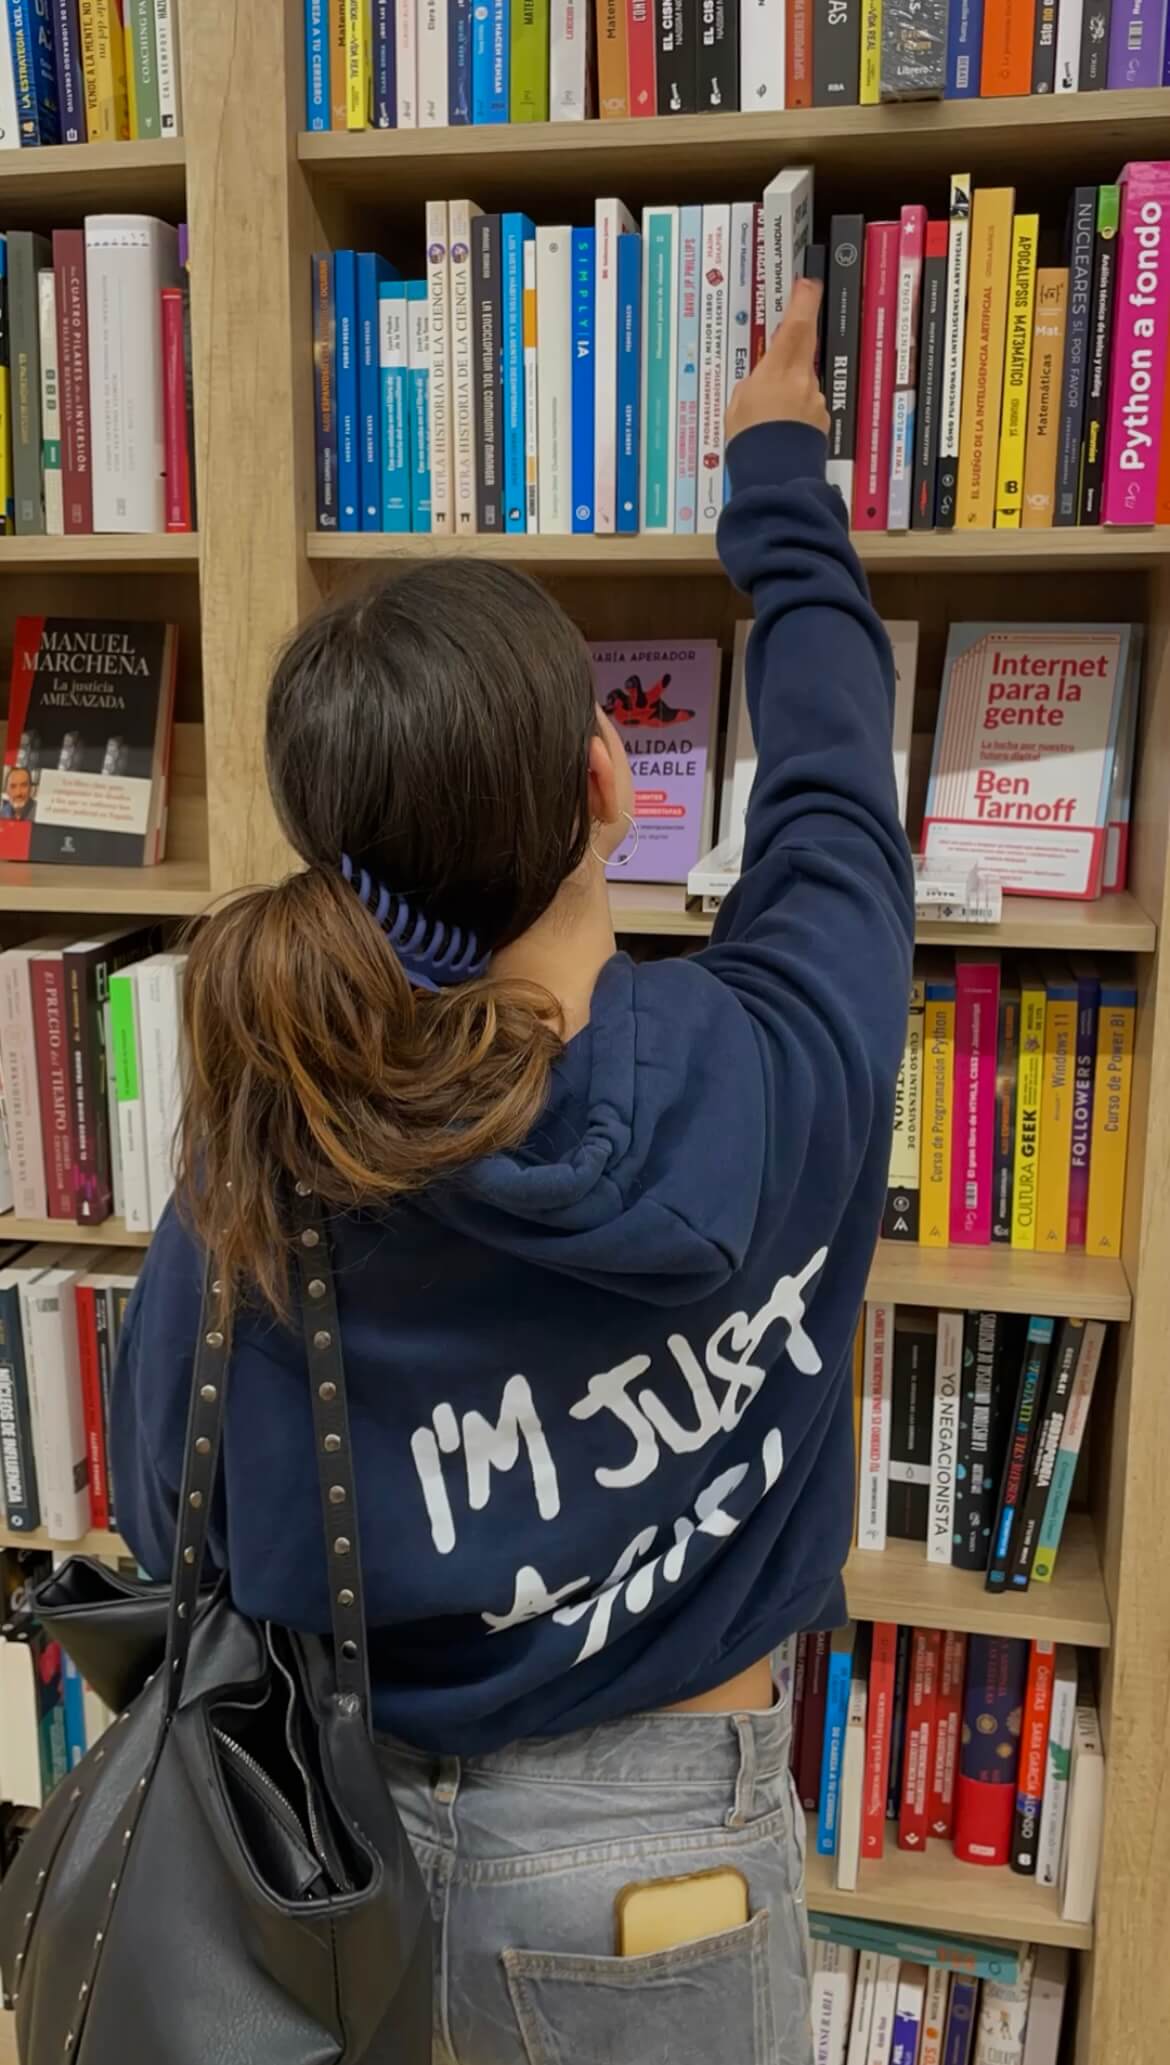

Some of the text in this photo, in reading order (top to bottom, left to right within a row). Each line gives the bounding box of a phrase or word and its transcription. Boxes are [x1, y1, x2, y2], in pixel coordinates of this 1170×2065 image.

[137, 17, 151, 84] COACHING
[663, 34, 675, 51] EL
[703, 27, 715, 45] EL
[1040, 23, 1053, 46] Esto
[87, 77, 98, 110] VENDE
[773, 214, 784, 259] JANDIAL
[774, 260, 784, 294] RAHUL
[1014, 235, 1034, 308] APOCALIPSIS
[1072, 202, 1094, 317] NUCLEARES
[1099, 253, 1112, 288] Análisis
[430, 270, 444, 328] CIENCIA
[453, 270, 468, 328] CIENCIA
[73, 331, 84, 383] PILARES
[430, 333, 443, 352] LA
[453, 333, 467, 352] LA
[577, 339, 590, 359] IA
[704, 322, 714, 352] MEJOR
[945, 231, 965, 449] CÓMO FUNCIONA LA INTELIGENCIA ARTIFICIAL
[1119, 201, 1164, 473] Python a fondo
[431, 359, 444, 378] DE
[454, 359, 467, 378] DE
[483, 372, 496, 387] DEL
[735, 346, 748, 380] Esta
[832, 354, 849, 412] RUBIK
[970, 286, 994, 500] EL SUEÑO DE LA INTELIGENCIA ARTIFICIAL
[1036, 353, 1054, 437] Matemáticas
[1066, 367, 1082, 410] FAVOR
[432, 385, 446, 454] HISTORIA
[454, 385, 470, 454] HISTORIA
[21, 652, 151, 677] MARCHENA
[39, 631, 137, 656] MANUEL
[629, 650, 697, 663] APERADOR
[53, 677, 115, 698] La justicia
[991, 653, 1109, 679] Internet
[39, 693, 126, 710] AMENAZADA
[987, 679, 1082, 706] para la
[983, 704, 1066, 731] gente
[975, 768, 1031, 797] Ben
[974, 795, 1079, 824] Tarnoff
[45, 988, 64, 1050] PRECIO
[933, 1010, 951, 1058] Python
[1051, 1012, 1071, 1089] Windows 11
[907, 1030, 921, 1150] CURSO INTENSIVO DE
[1102, 1012, 1124, 1134] Curso de Power BI
[52, 1068, 68, 1133] TIEMPO
[1071, 1055, 1091, 1168] FOLLOWERS
[933, 1132, 943, 1146] de
[1018, 1109, 1037, 1229] CULTURA GEEK
[410, 1373, 561, 1554] I'M
[568, 1245, 830, 1489] JUST
[1, 1421, 15, 1438] DE
[3, 1438, 23, 1506] INFLUENCIA
[933, 1372, 957, 1537] YO, NEGACIONISTA
[1020, 1792, 1040, 1839] ALONSO
